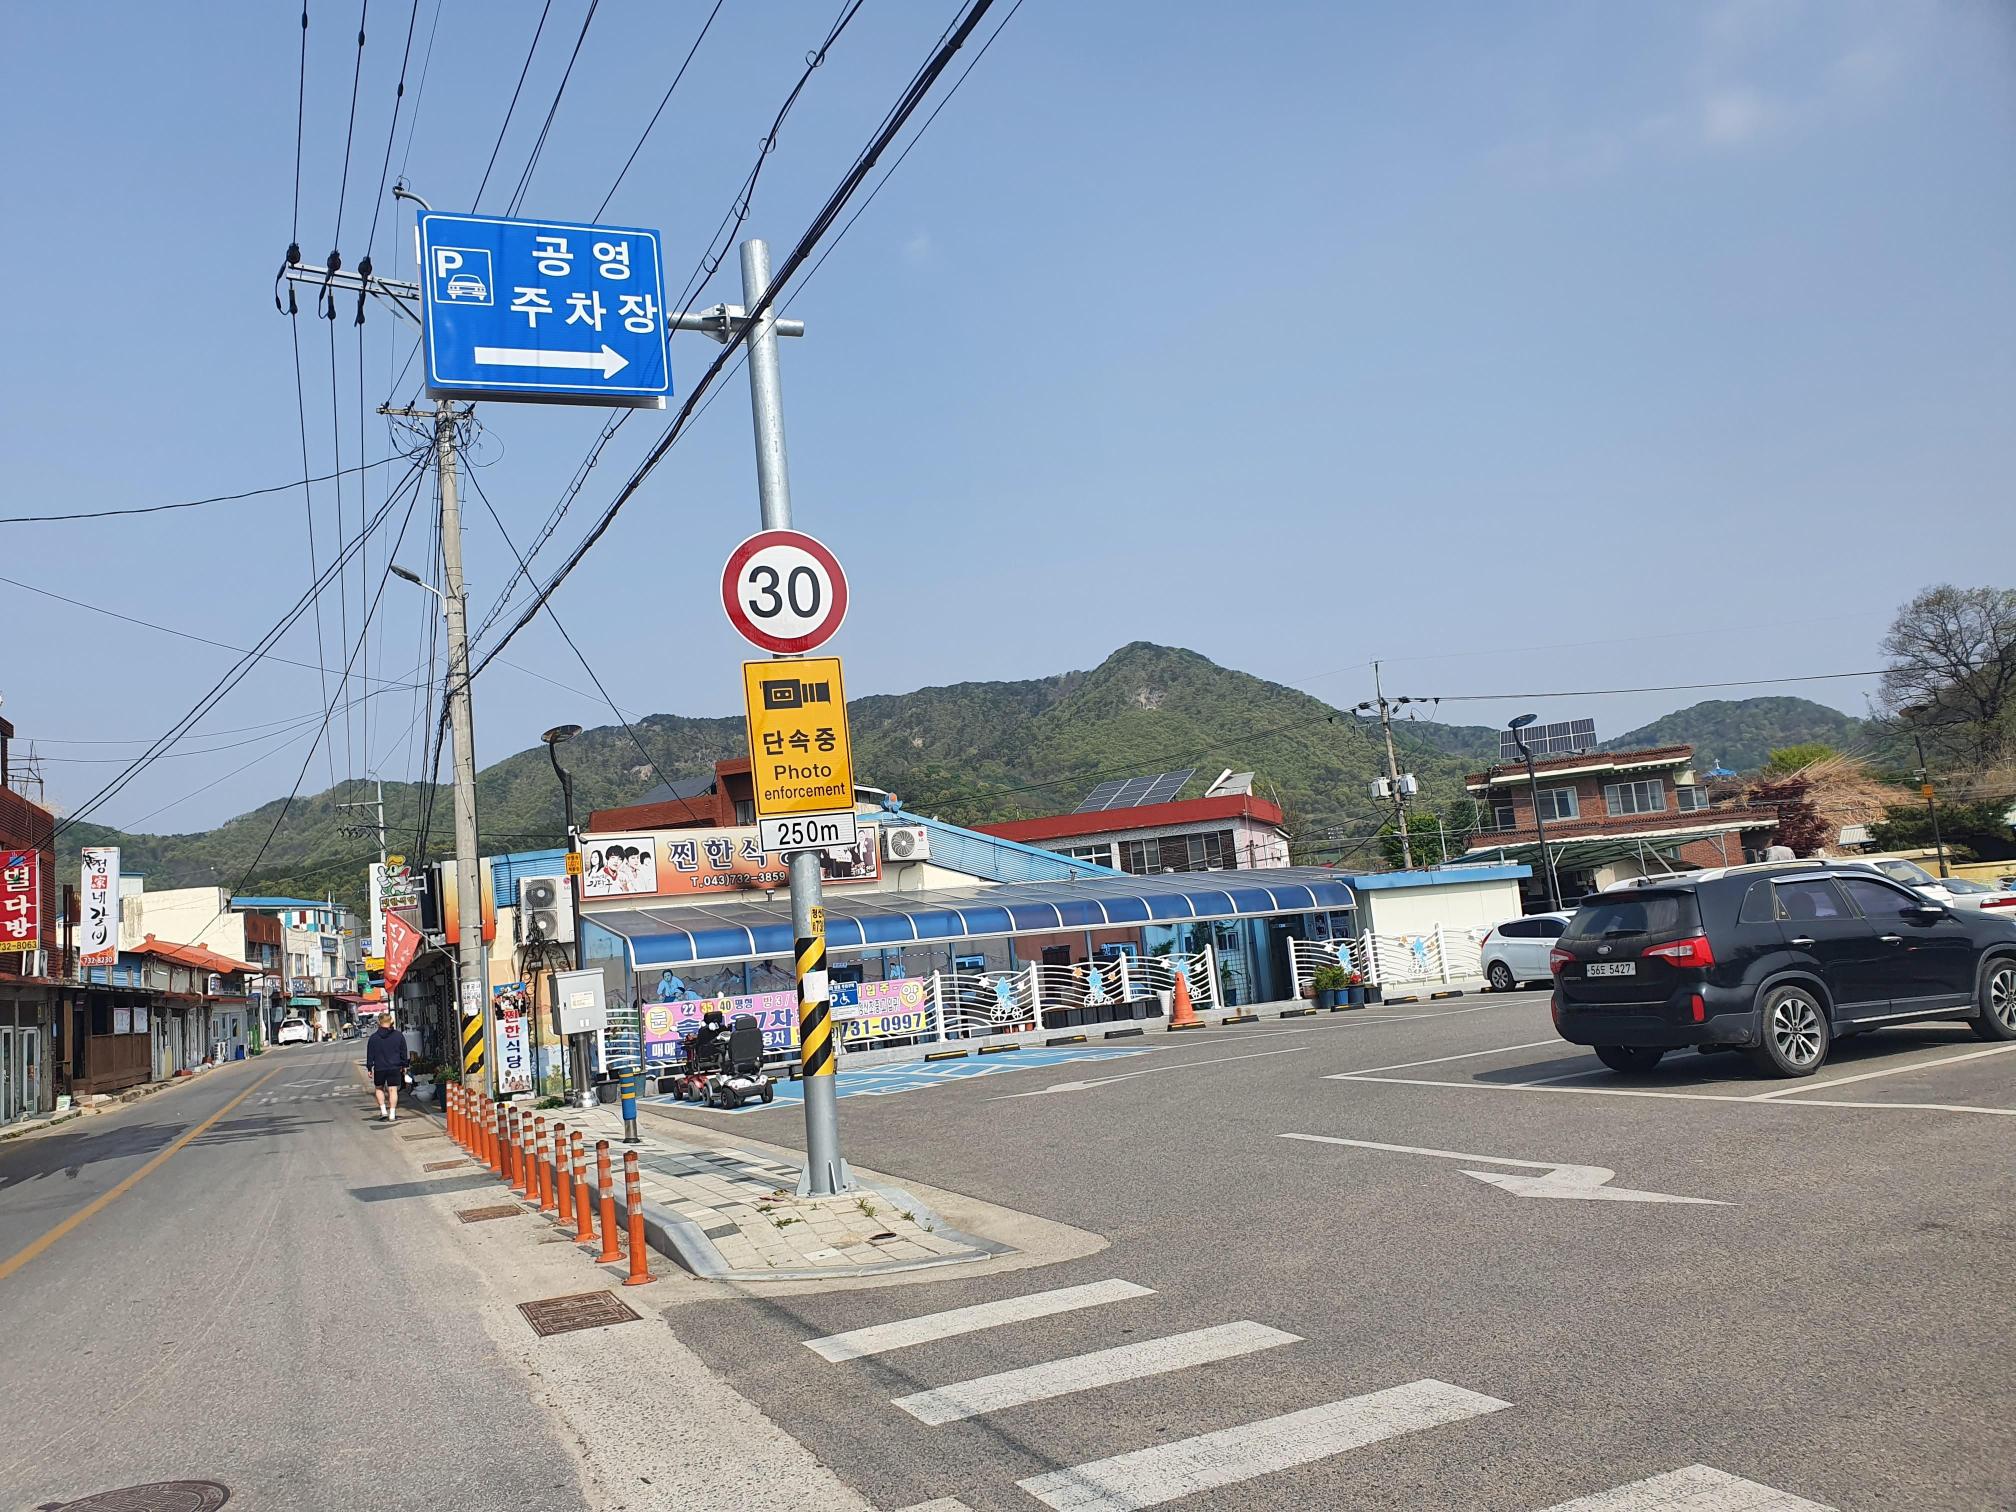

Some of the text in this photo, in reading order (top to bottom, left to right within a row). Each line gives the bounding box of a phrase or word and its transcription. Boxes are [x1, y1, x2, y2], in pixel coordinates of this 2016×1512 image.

[437, 250, 464, 278] P
[531, 236, 631, 280] 공영
[510, 286, 658, 334] 주차장
[748, 565, 821, 618] 30
[763, 727, 837, 756] 단속중
[774, 763, 832, 781] Photo
[764, 782, 846, 801] enforcement
[777, 820, 840, 845] 250m
[669, 836, 788, 872] 찐한식
[1609, 963, 1630, 975] 5427
[682, 1003, 694, 1015] 22
[701, 1002, 713, 1013] 35
[719, 1000, 731, 1012] 40
